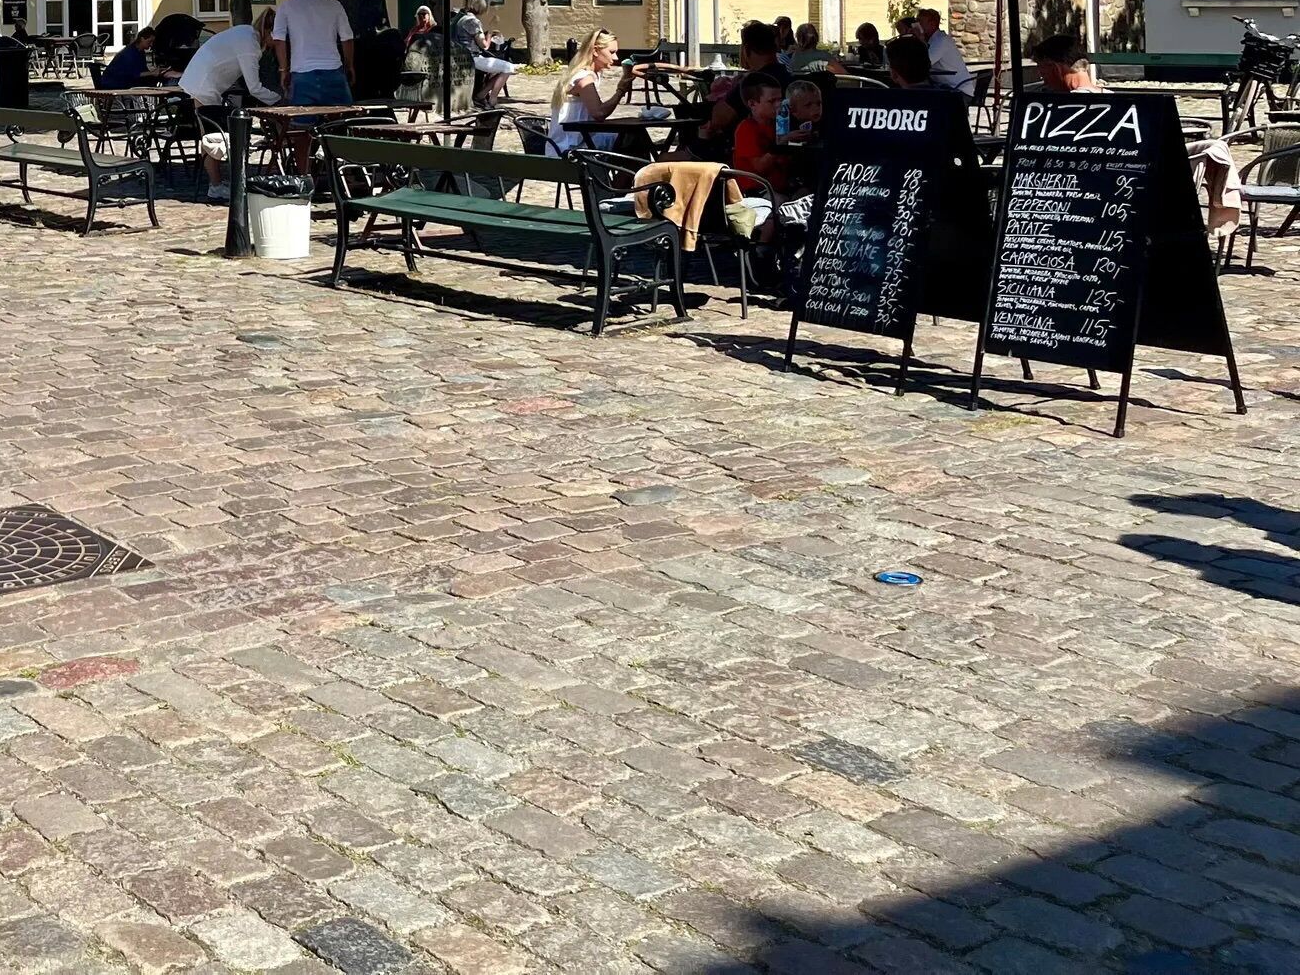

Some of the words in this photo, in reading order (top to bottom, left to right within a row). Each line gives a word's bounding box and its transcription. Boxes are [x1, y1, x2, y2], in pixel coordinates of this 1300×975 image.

[848, 107, 928, 131] TUBORG
[825, 198, 856, 209] KAFFE
[1008, 197, 1071, 212] PEPPERONI
[1005, 219, 1053, 235] PATATE
[813, 257, 847, 272] APEROL
